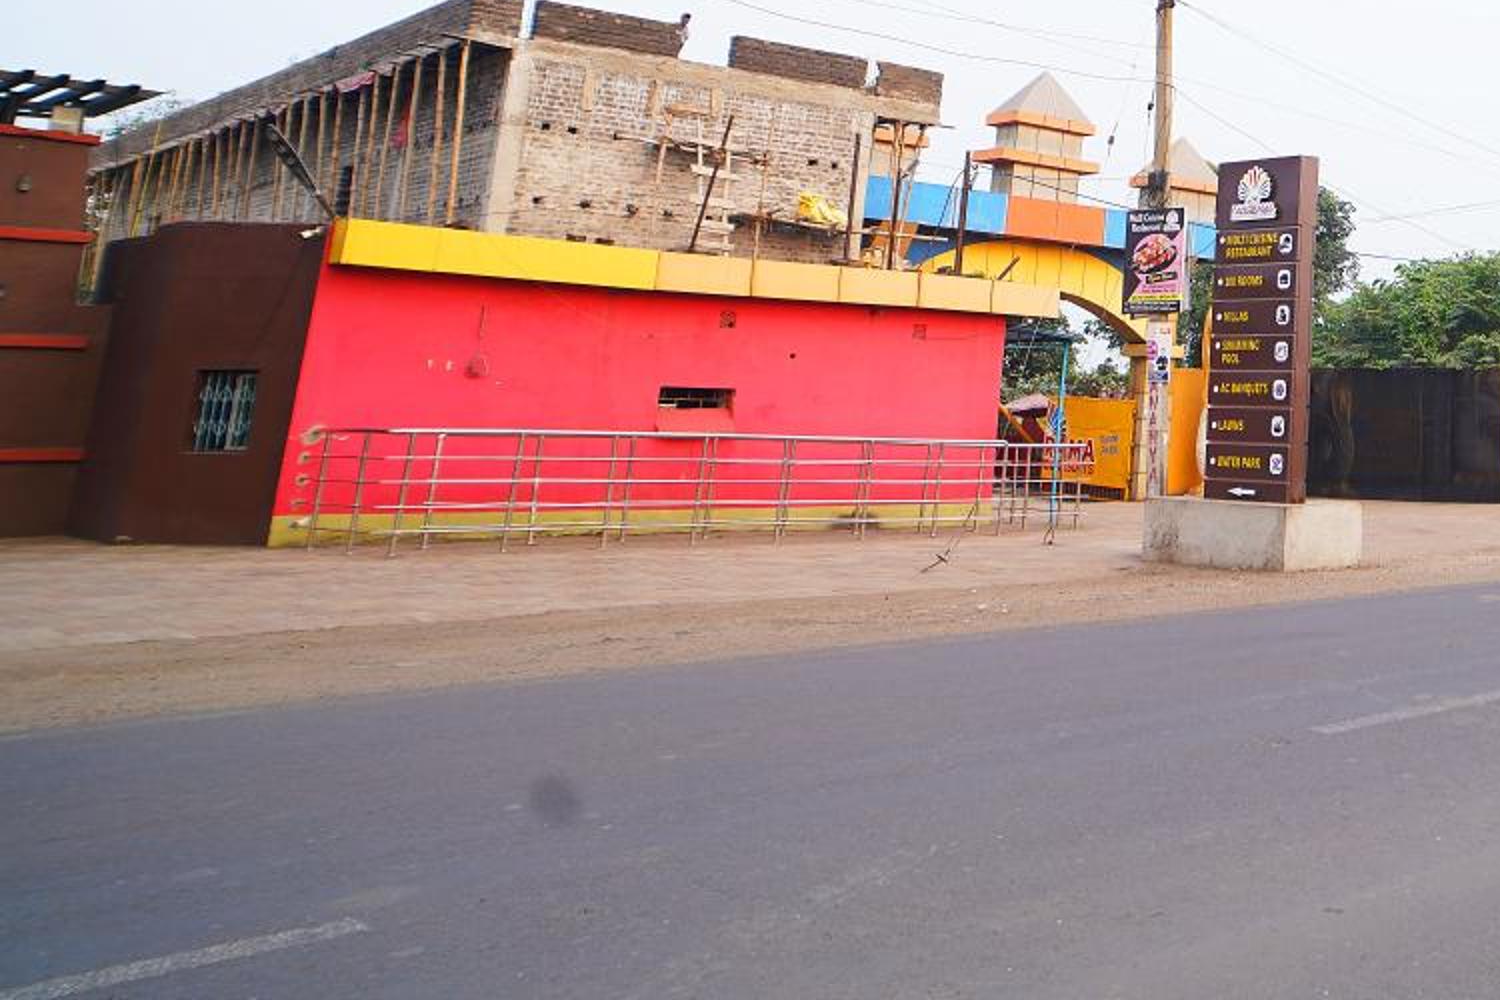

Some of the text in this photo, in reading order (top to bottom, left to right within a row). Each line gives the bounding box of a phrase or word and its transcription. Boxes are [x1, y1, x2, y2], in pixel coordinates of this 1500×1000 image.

[1237, 275, 1263, 287] ROOMS
[1221, 353, 1239, 364] POOL
[1220, 382, 1230, 393] AC
[1242, 457, 1261, 469] PARK
